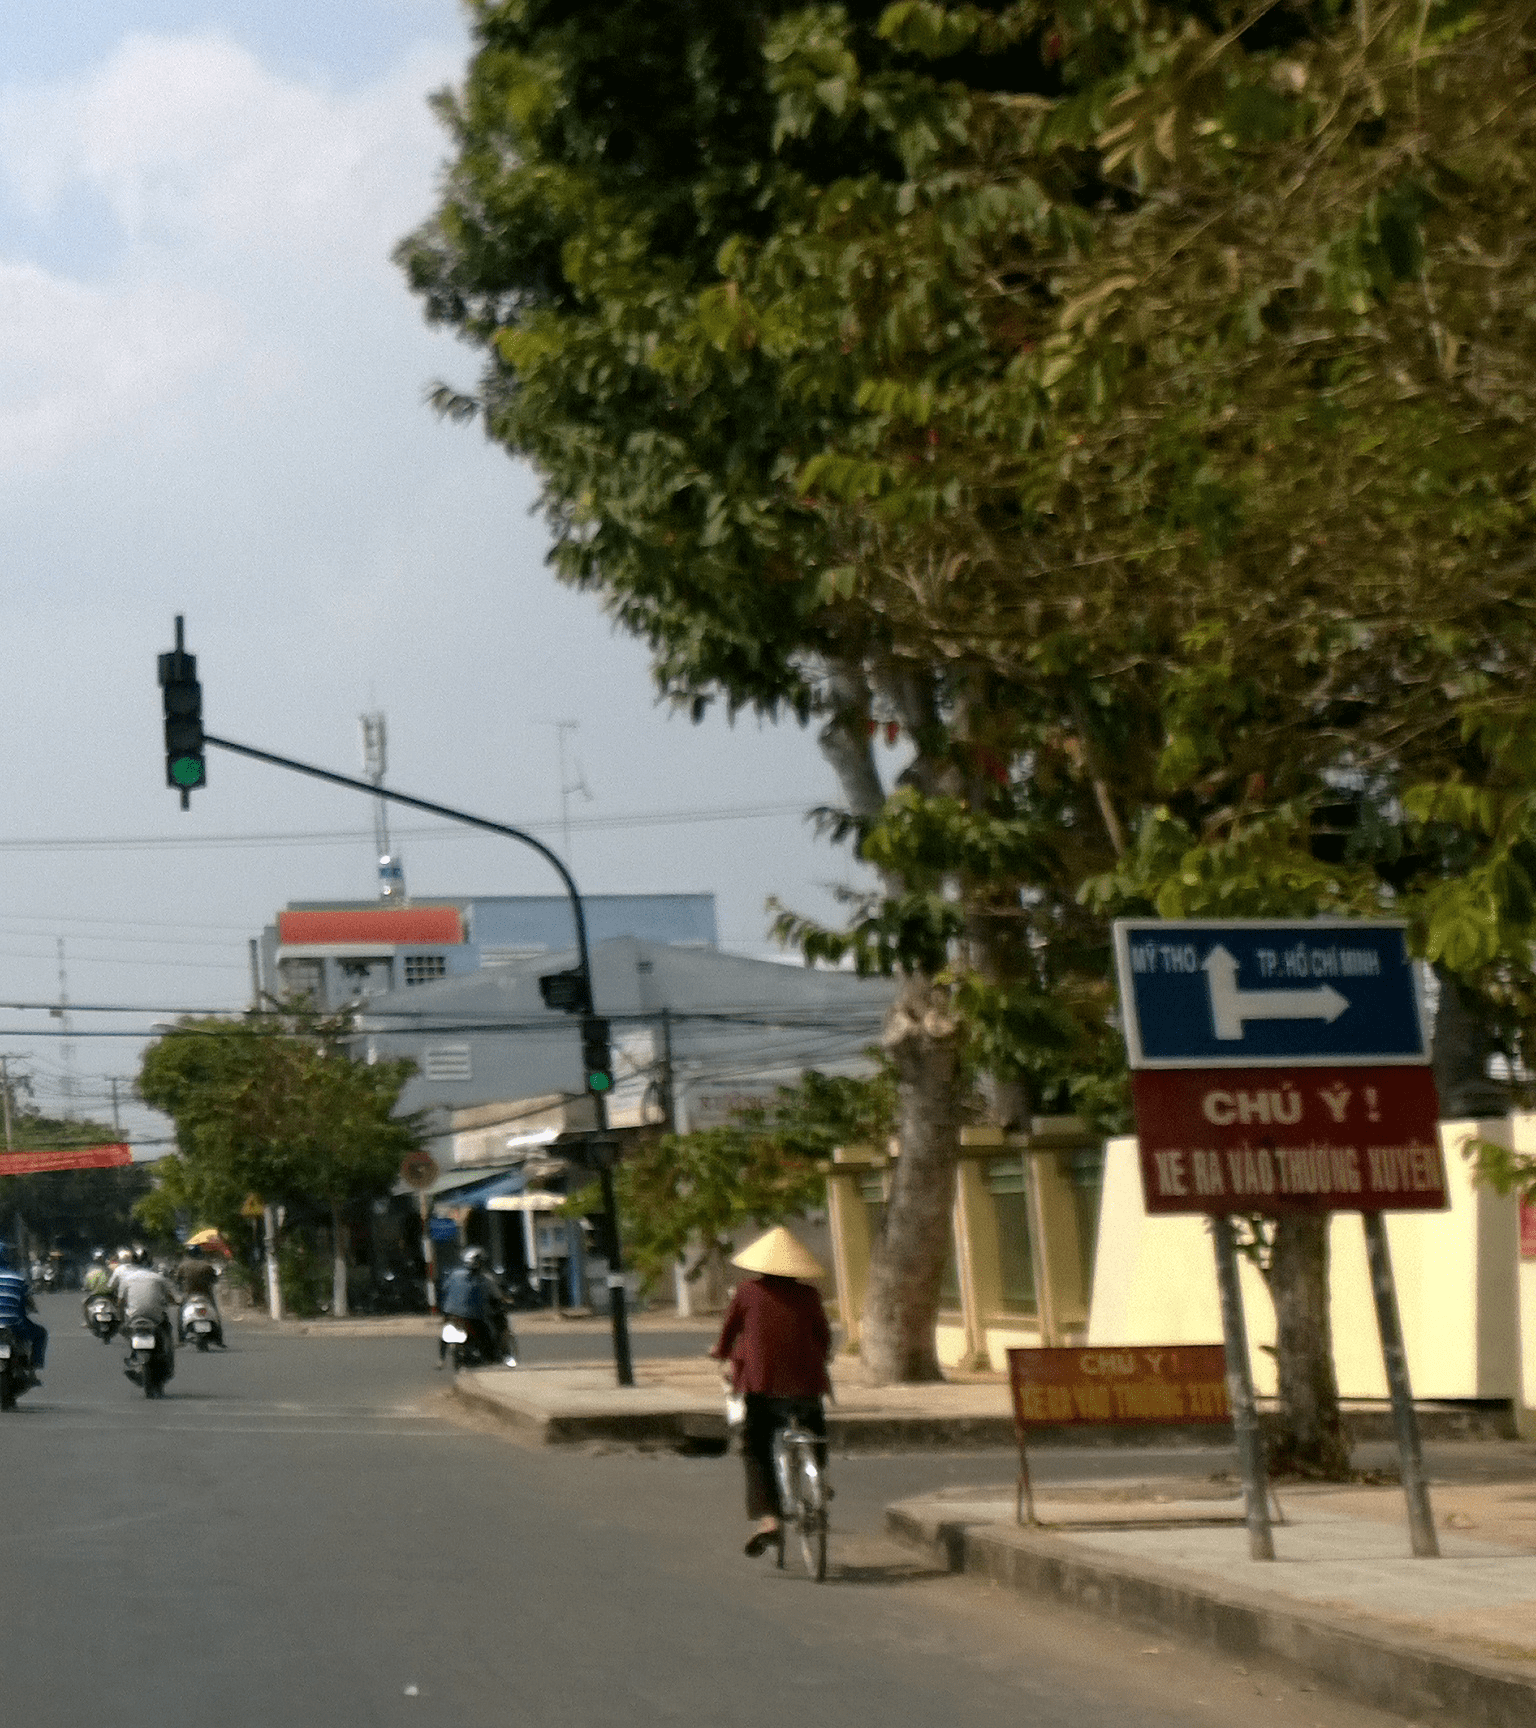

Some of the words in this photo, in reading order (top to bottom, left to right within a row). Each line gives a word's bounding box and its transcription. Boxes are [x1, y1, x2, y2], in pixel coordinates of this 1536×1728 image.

[1160, 945, 1196, 973] THO
[1340, 948, 1381, 977] MINH
[1202, 1081, 1303, 1125] CHÚ
[1319, 1081, 1353, 1123] Ý
[1365, 1087, 1381, 1122] !
[1154, 1150, 1188, 1196] XE
[1192, 1149, 1224, 1195] RA
[1228, 1140, 1274, 1195] VÀO
